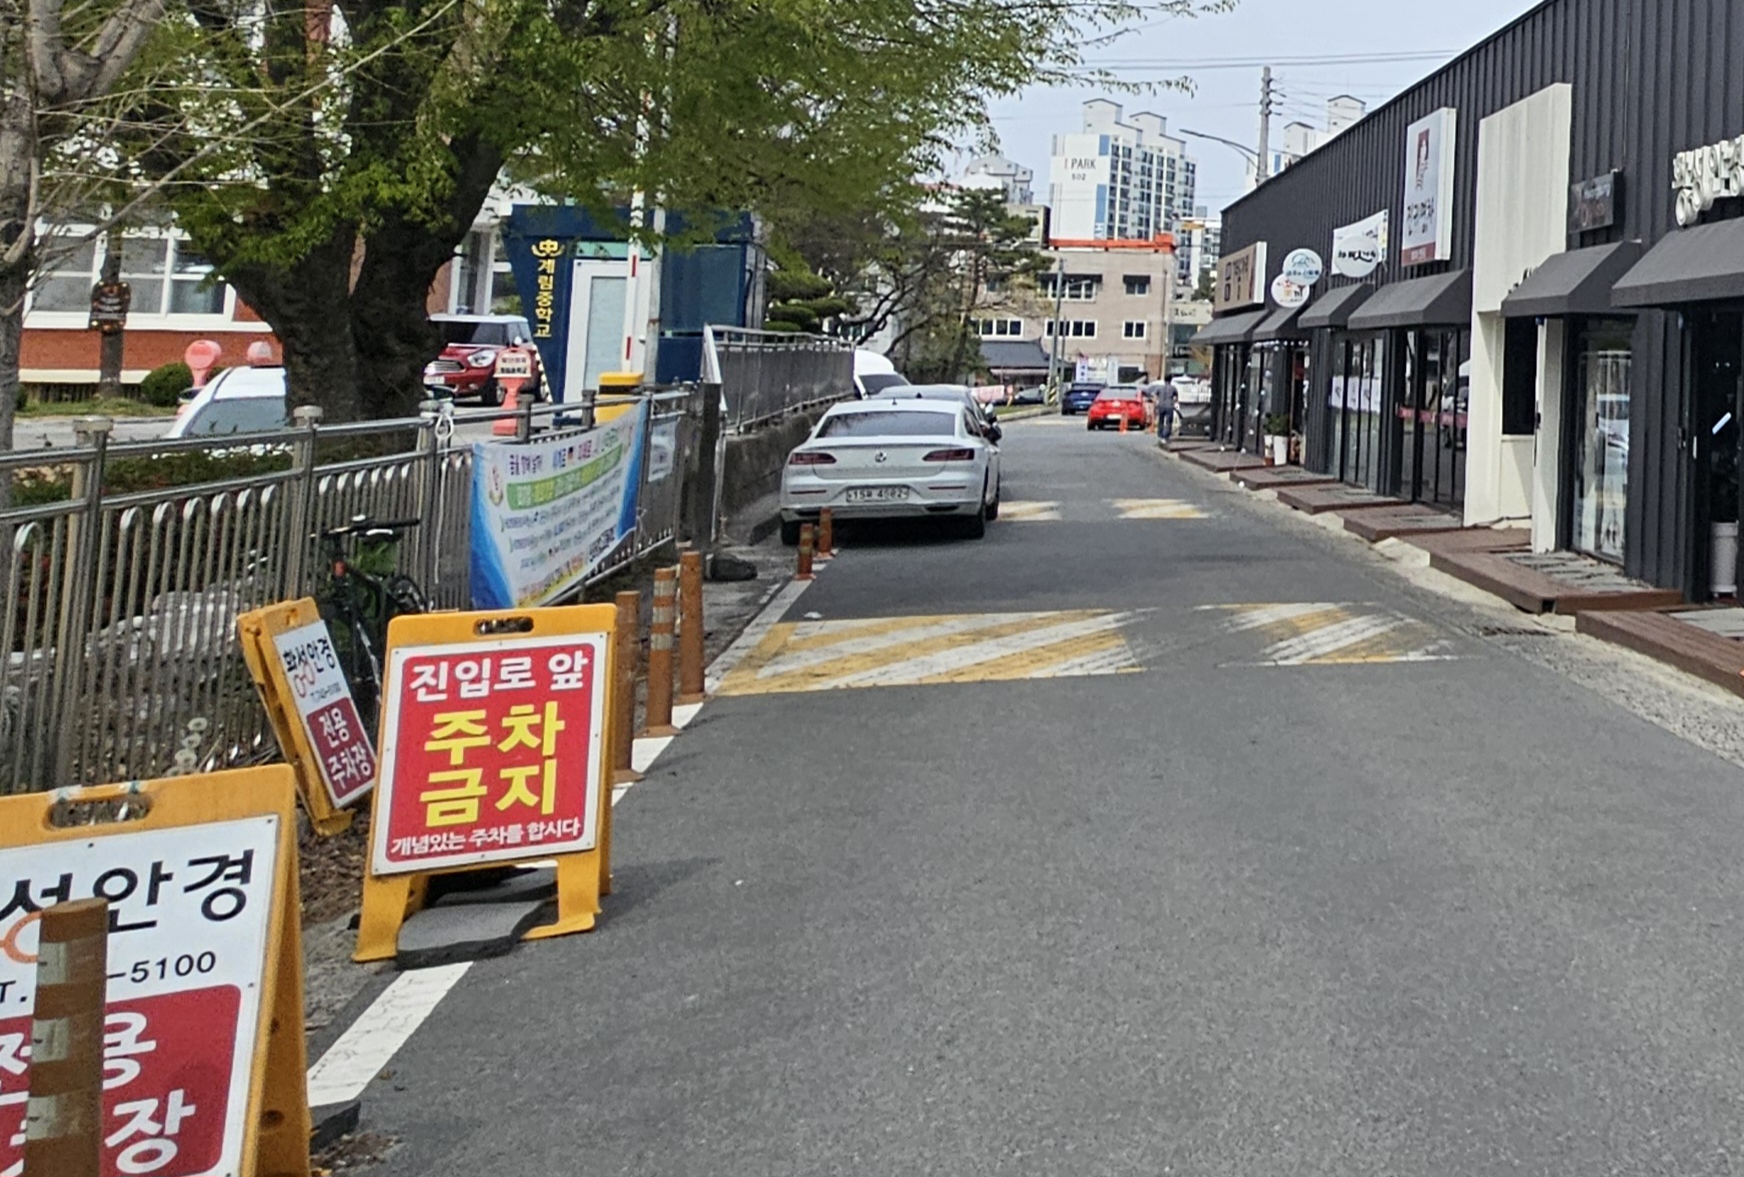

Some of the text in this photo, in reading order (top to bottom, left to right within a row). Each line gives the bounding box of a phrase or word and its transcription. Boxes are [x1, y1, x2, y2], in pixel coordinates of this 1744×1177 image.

[533, 258, 556, 338] 계림중학교
[409, 650, 589, 702] 진입로 앞
[424, 701, 566, 766] 주차
[328, 741, 372, 790] 주차장
[419, 758, 558, 828] 금지
[391, 816, 581, 856] 개념있는 주차를 합시다
